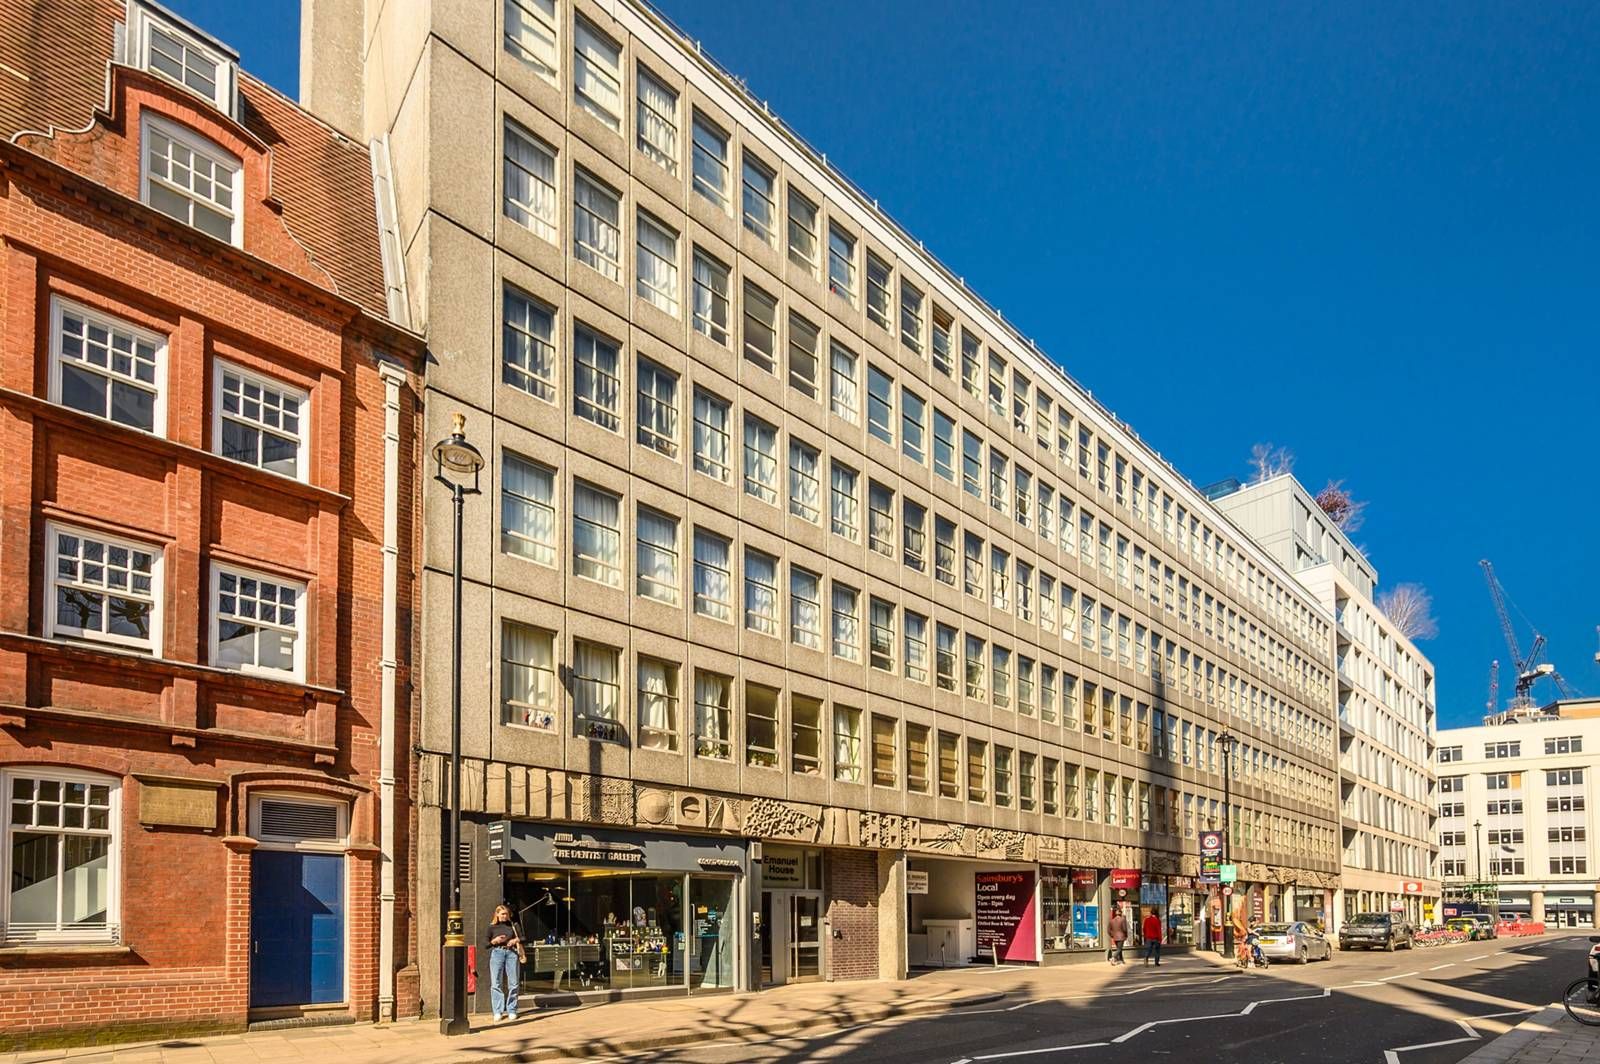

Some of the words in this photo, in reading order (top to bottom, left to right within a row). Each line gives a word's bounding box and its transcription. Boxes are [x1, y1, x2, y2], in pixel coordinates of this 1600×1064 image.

[1206, 837, 1217, 845] 20
[552, 849, 570, 858] THE
[570, 850, 606, 860] DENTIST
[608, 852, 642, 862] GALLERY
[763, 856, 799, 866] Emanuel
[768, 865, 795, 874] House
[977, 874, 1024, 883] Sainsbury's
[977, 883, 998, 891] Local
